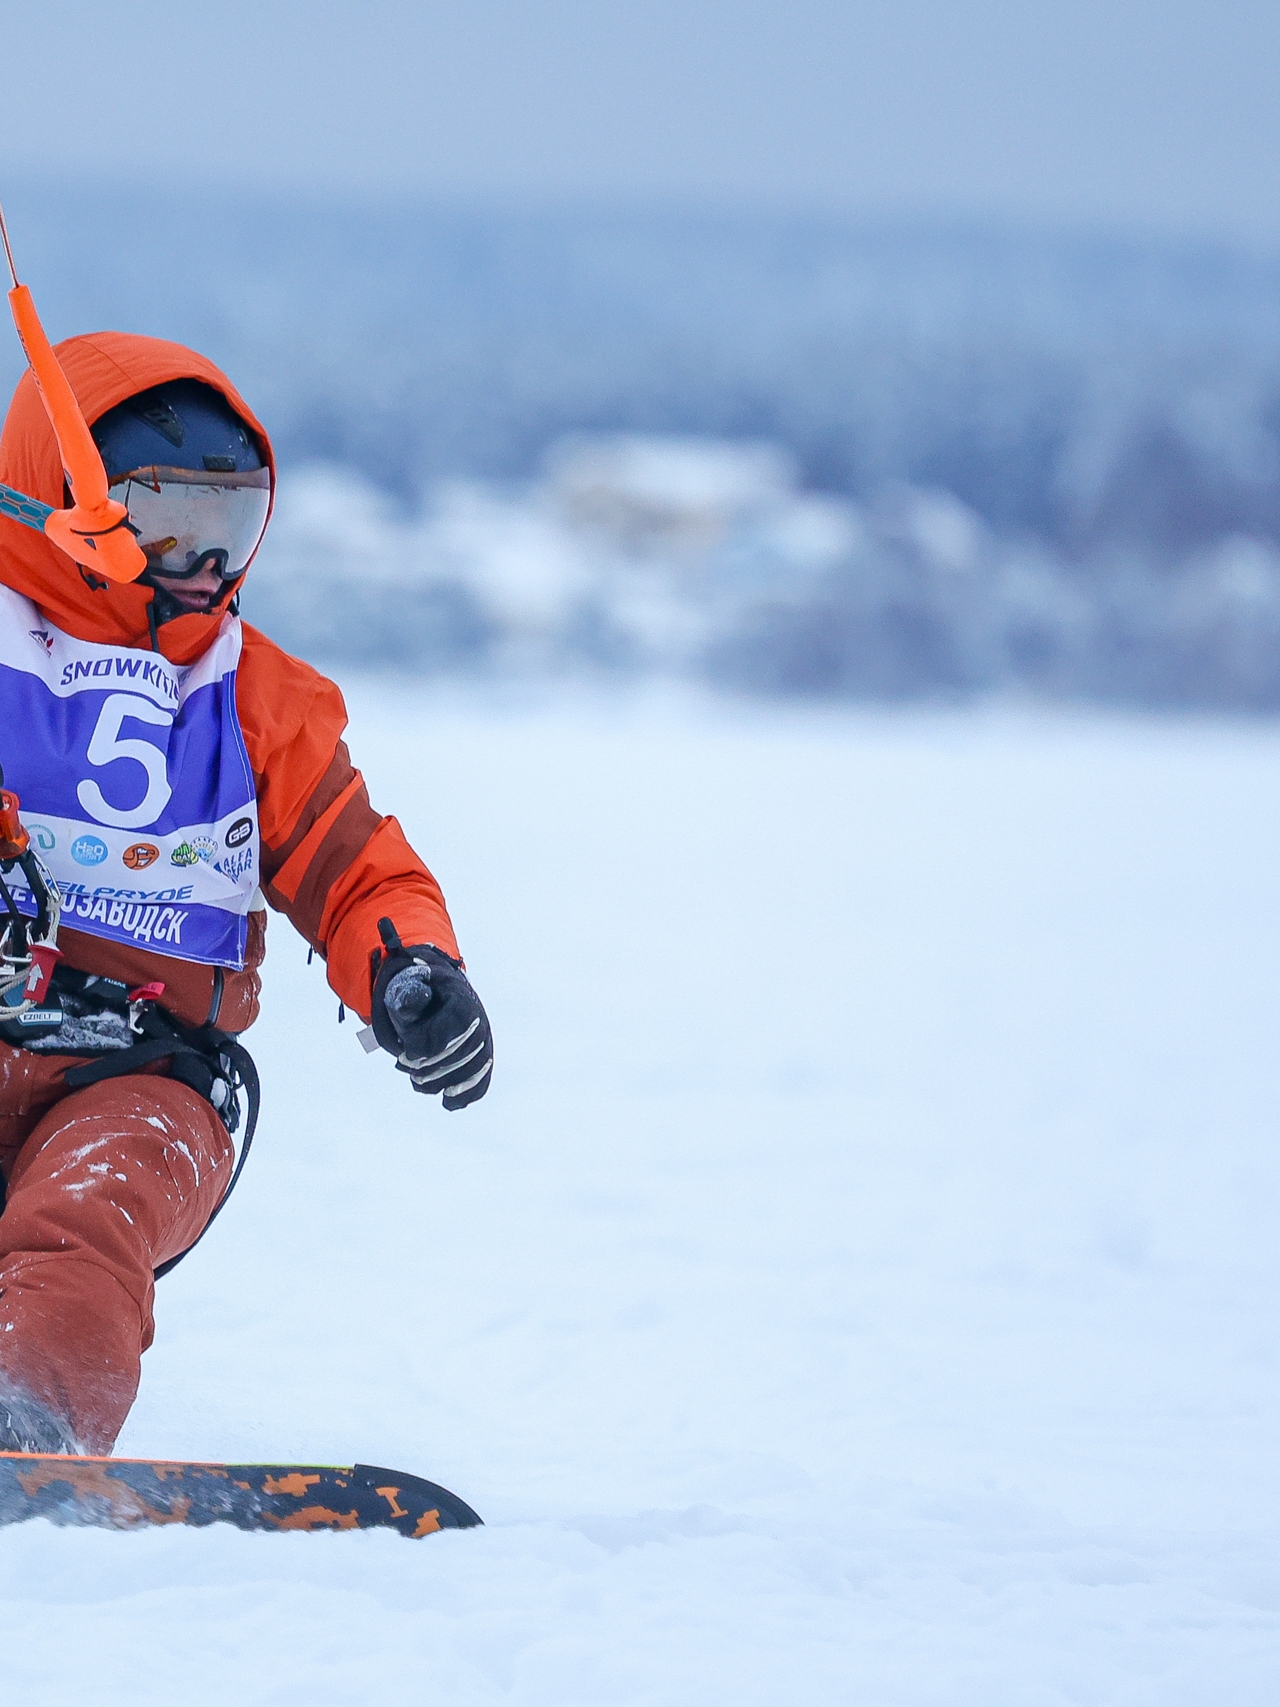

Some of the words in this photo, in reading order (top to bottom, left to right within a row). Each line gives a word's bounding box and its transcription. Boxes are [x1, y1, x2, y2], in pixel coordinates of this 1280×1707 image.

[77, 692, 173, 829] 5
[76, 841, 104, 855] H2O
[223, 847, 252, 871] ALFA
